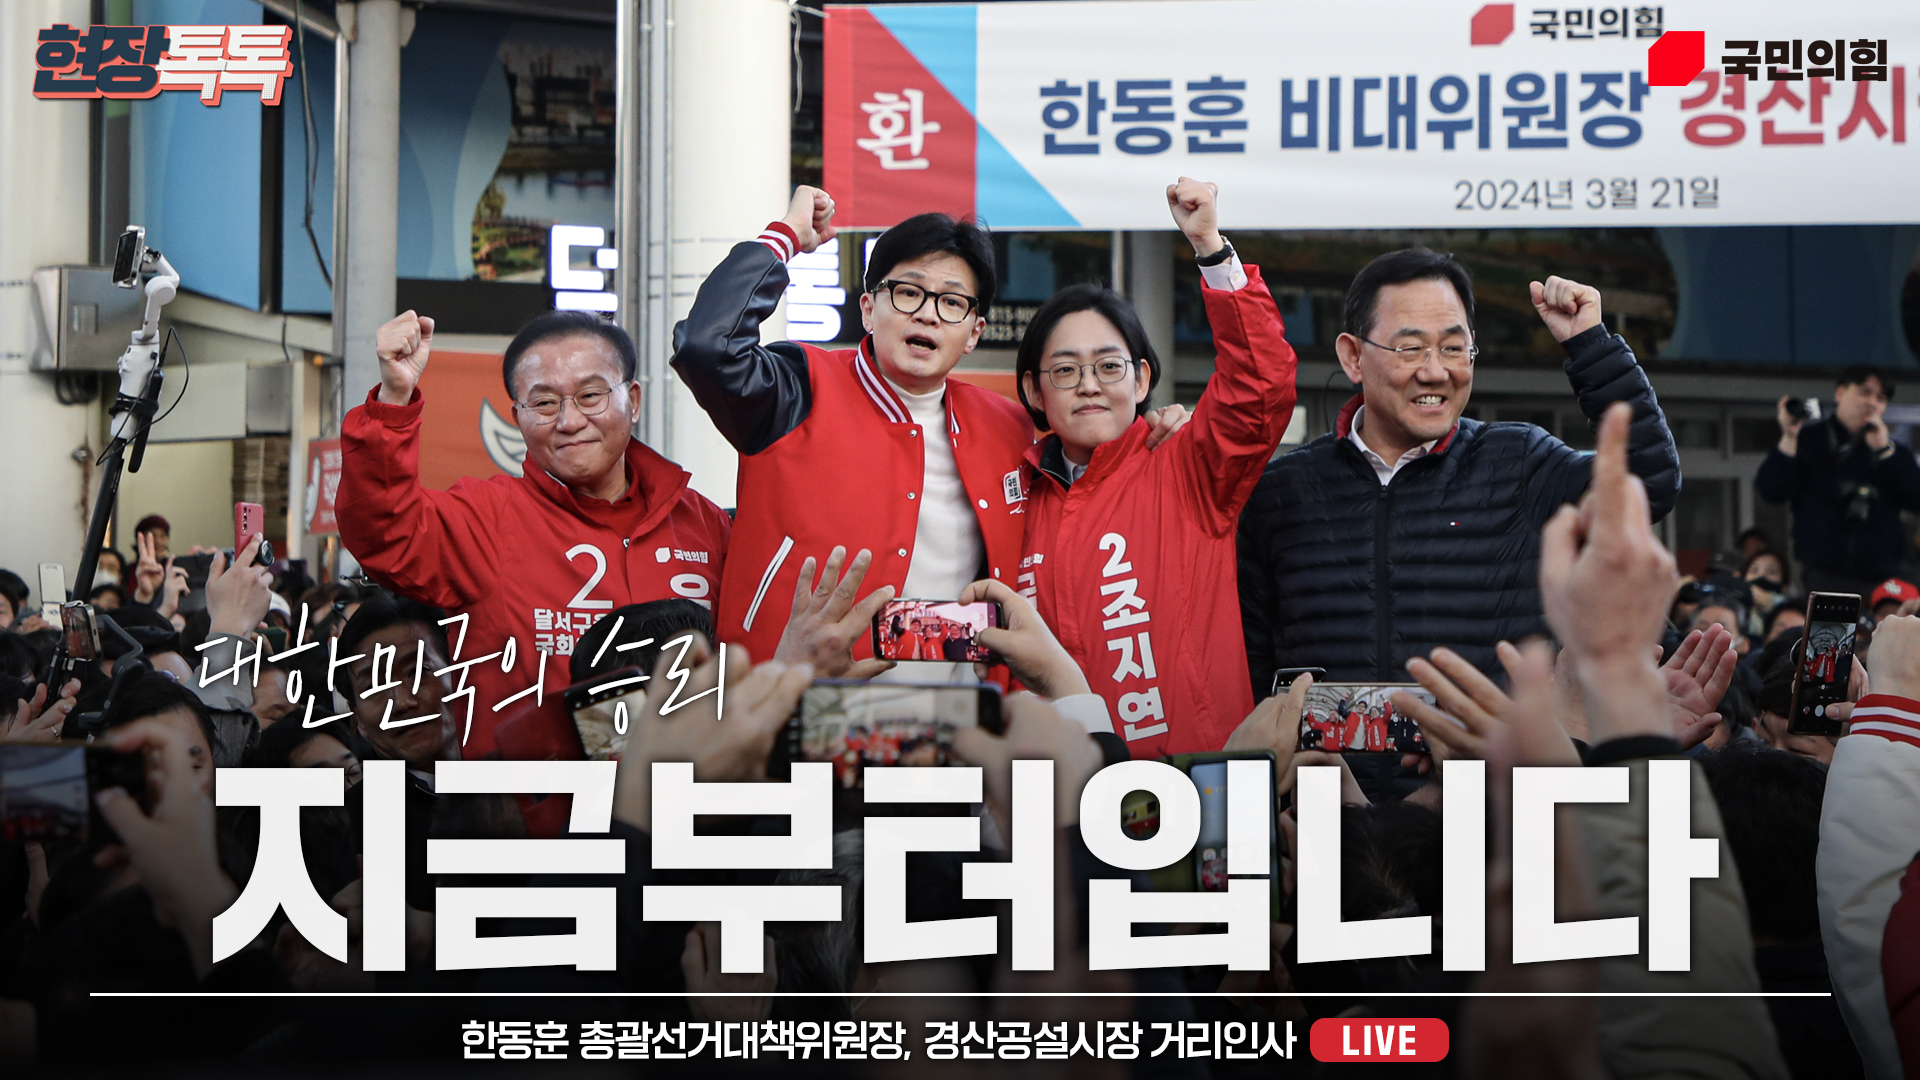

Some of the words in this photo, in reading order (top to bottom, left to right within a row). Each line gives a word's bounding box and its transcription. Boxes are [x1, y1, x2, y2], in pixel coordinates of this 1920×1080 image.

[1529, 6, 1664, 39] 국민의힘
[1040, 75, 1249, 156] 한동훈
[1281, 70, 1650, 152] 비대위원장
[1680, 66, 1920, 147] 경산시
[856, 87, 942, 171] 환
[1455, 180, 1573, 211] 2024년
[1586, 178, 1637, 210] 3월
[1651, 178, 1719, 209] 21일
[673, 549, 709, 564] 국민의힘
[565, 543, 614, 609] 2
[535, 633, 582, 657] 국회
